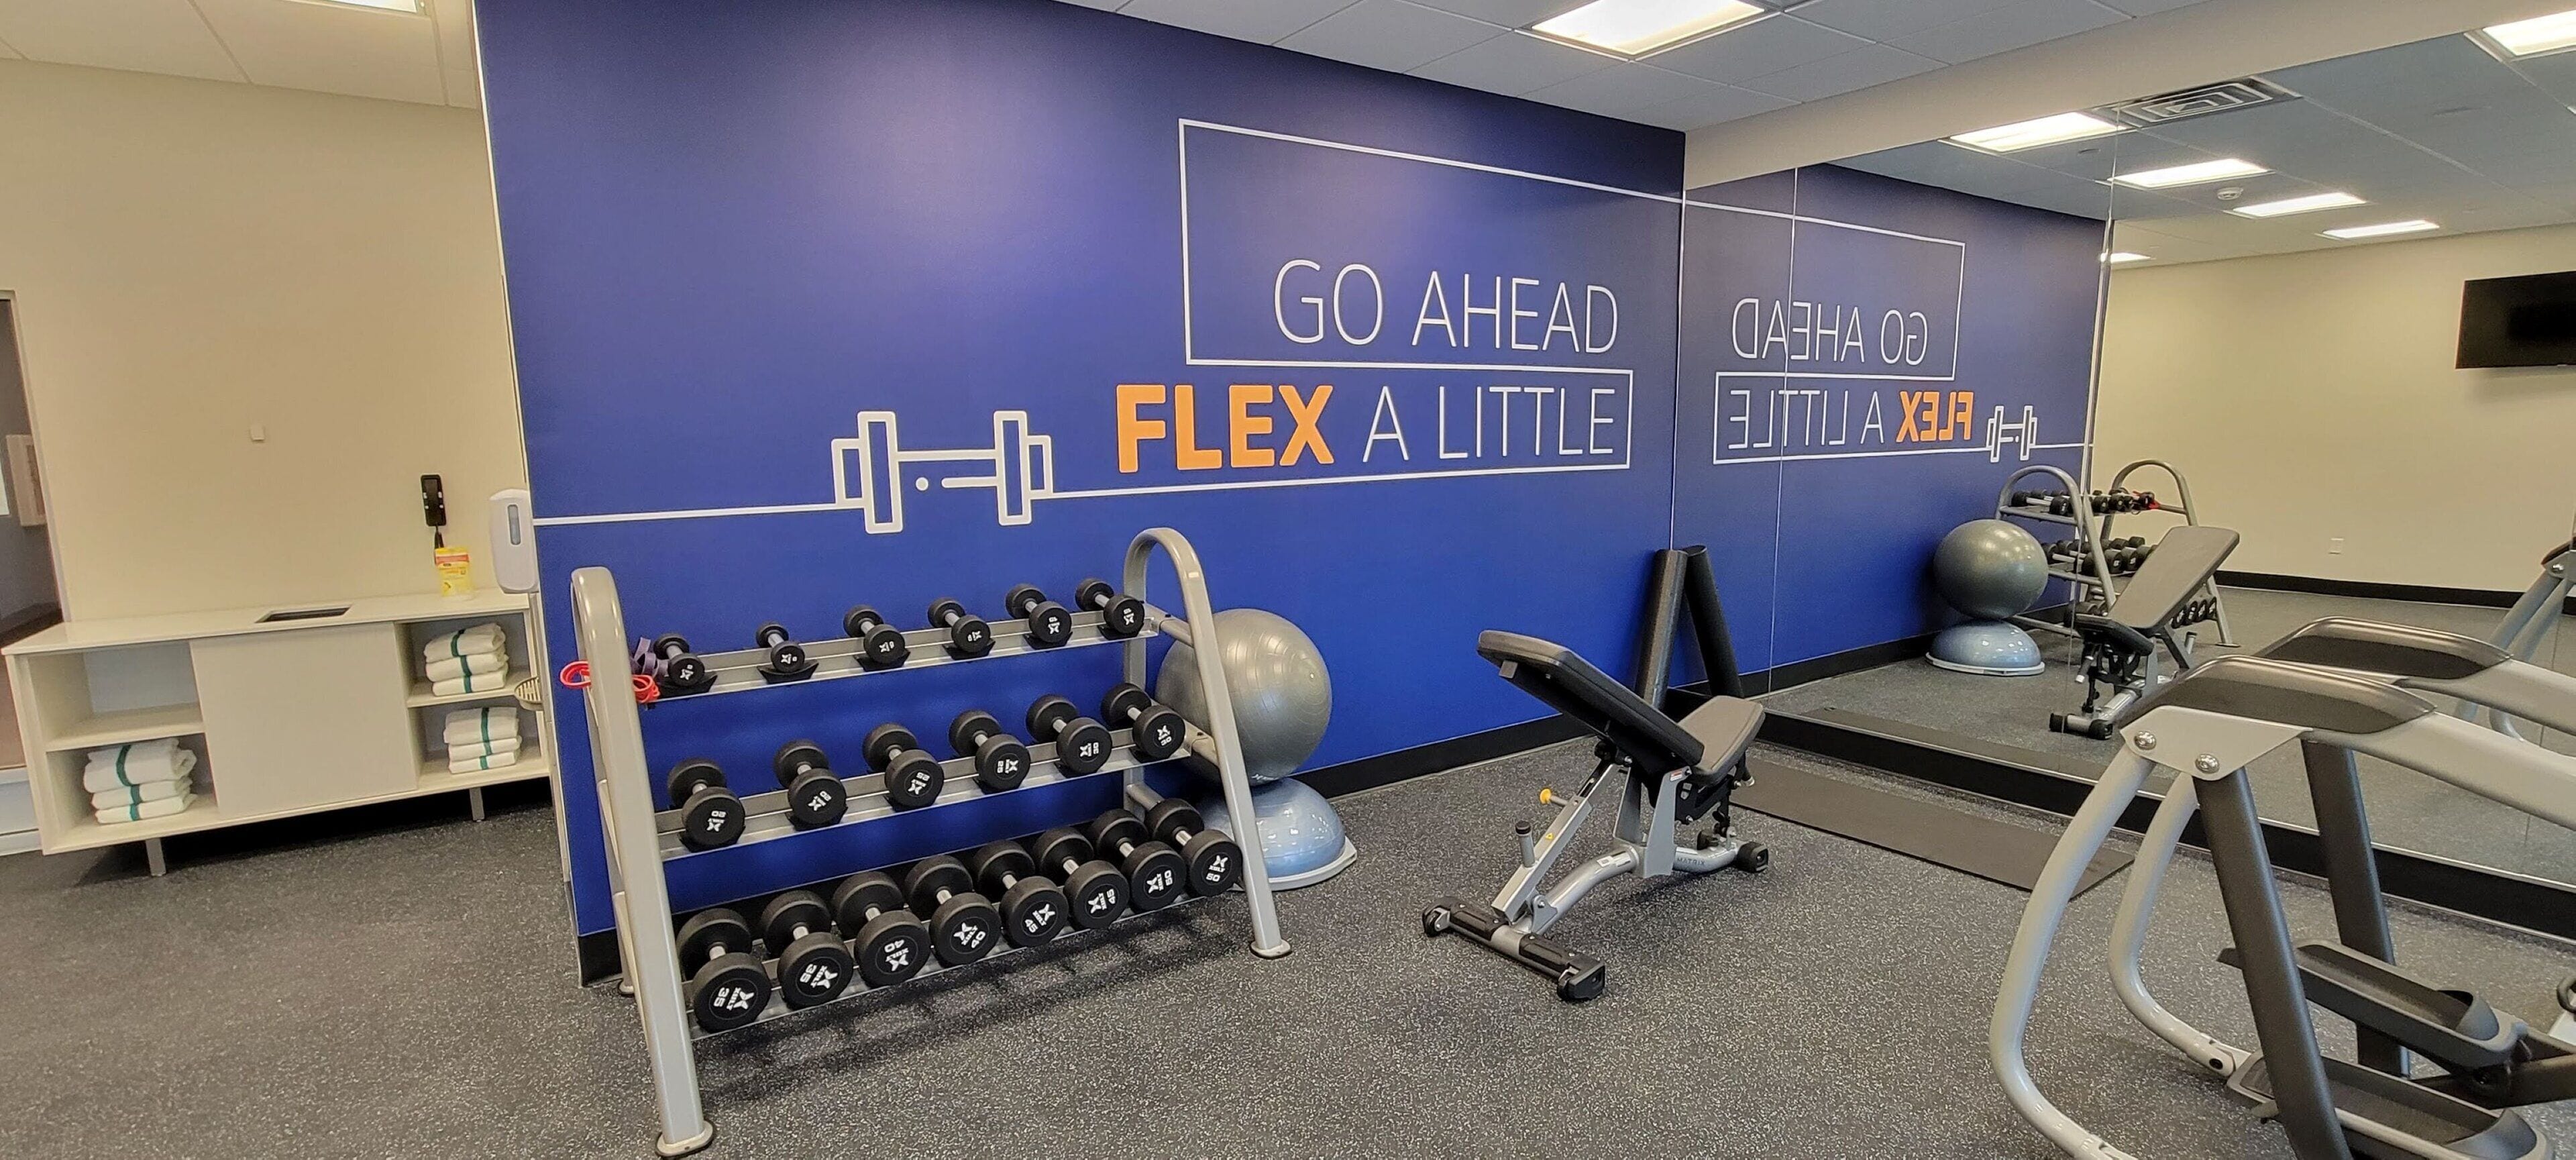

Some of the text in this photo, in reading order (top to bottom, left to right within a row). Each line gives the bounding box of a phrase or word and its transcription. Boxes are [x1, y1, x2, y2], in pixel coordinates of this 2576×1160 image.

[1274, 259, 1619, 354] GO AHEAD
[1116, 384, 1615, 474] FLEX A LITTLE
[997, 760, 1005, 774] 25
[916, 772, 930, 782] 25
[1677, 857, 1705, 865] MATRIX
[1164, 869, 1173, 886] 50
[1205, 873, 1221, 882] 50
[1107, 888, 1116, 904] 45
[1024, 919, 1038, 933] 45
[884, 939, 905, 953] 40
[971, 931, 986, 948] 40
[799, 963, 818, 983] 35
[713, 987, 730, 1007] 35
